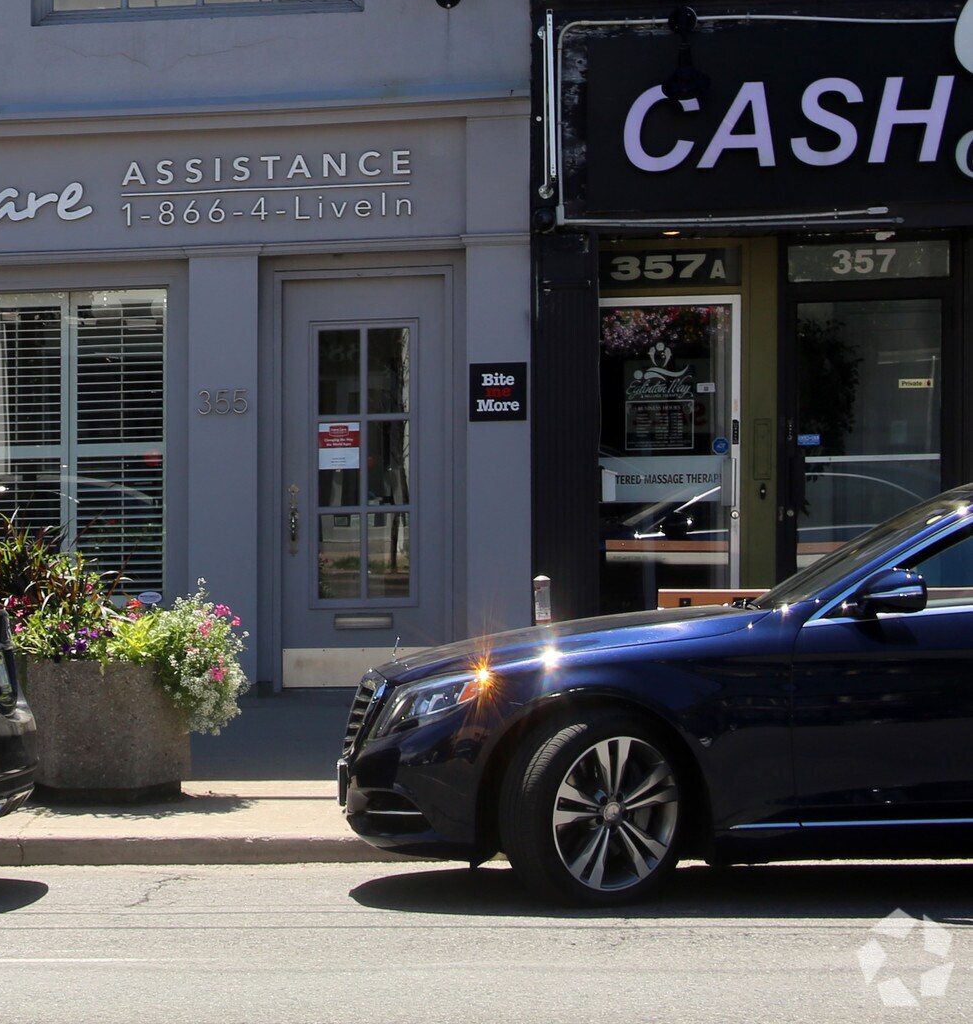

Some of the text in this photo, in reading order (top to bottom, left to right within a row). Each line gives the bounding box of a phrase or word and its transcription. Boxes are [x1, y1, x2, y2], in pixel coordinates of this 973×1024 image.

[622, 75, 954, 173] CASH
[121, 149, 411, 186] ASSISTANCE
[831, 248, 897, 275] 357
[481, 372, 515, 387] Bite
[485, 386, 511, 397] me
[197, 389, 249, 416] 355
[476, 398, 520, 412] More
[615, 472, 722, 485] TERED MASSAGE THERAP
